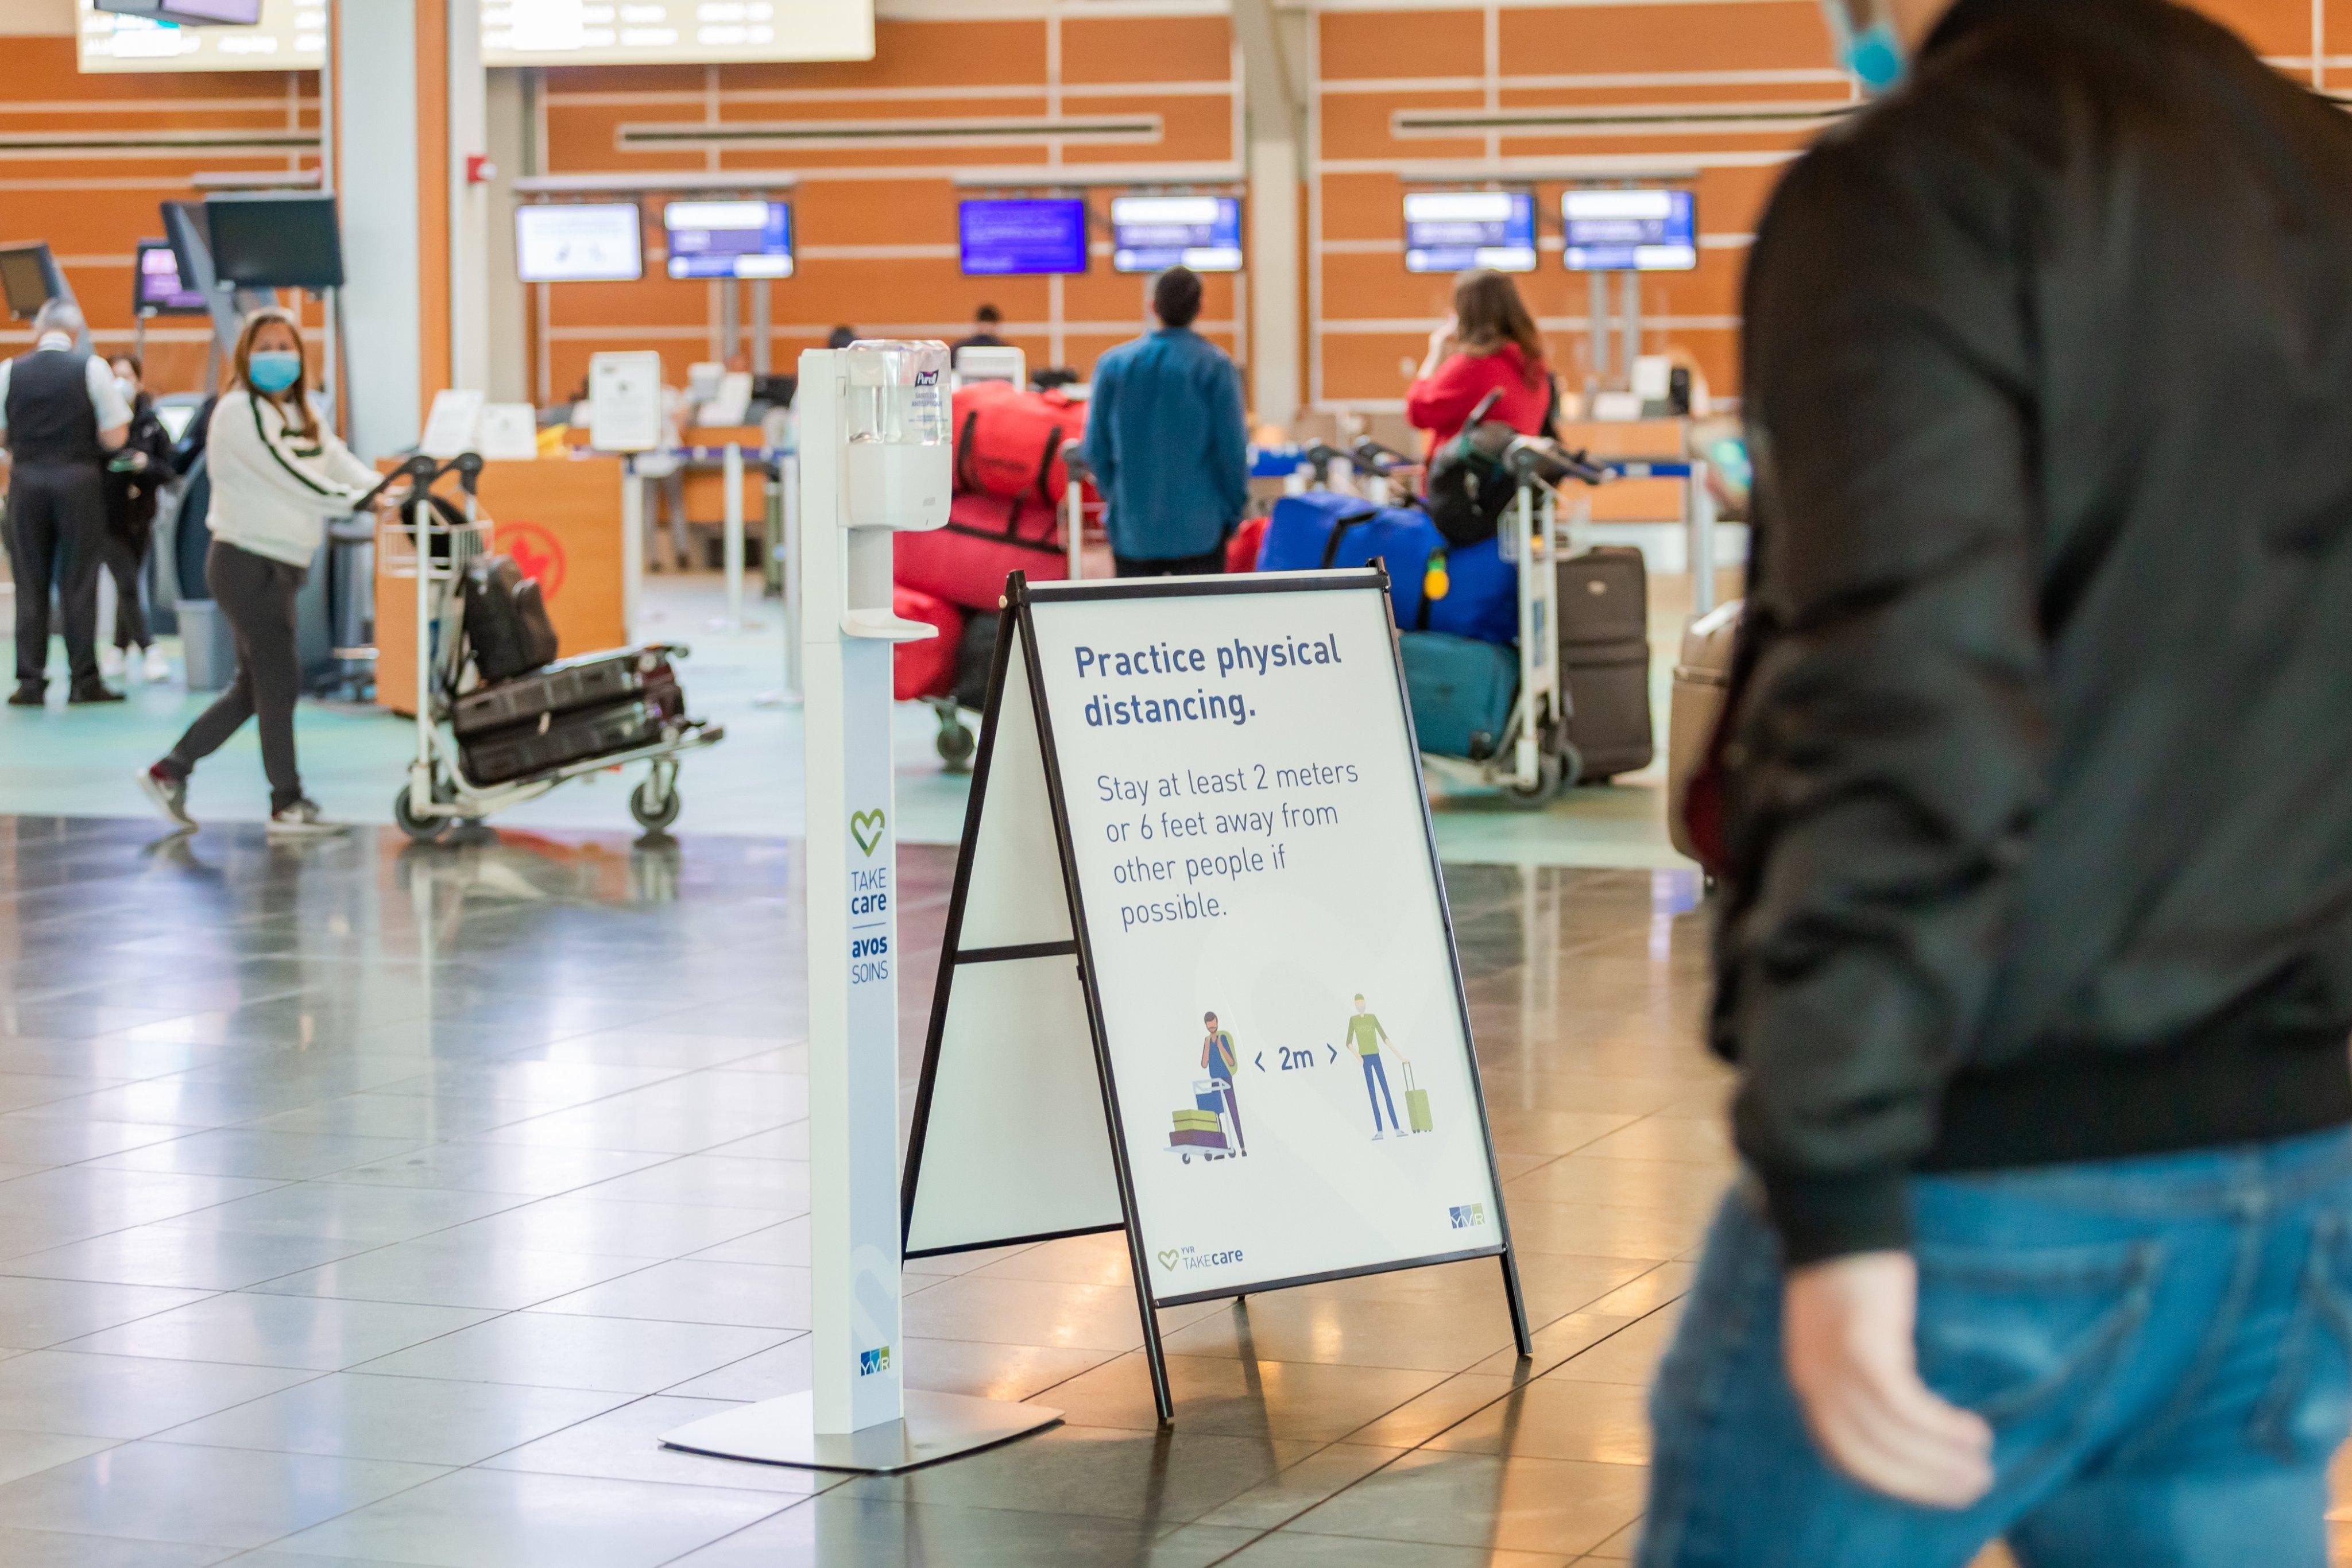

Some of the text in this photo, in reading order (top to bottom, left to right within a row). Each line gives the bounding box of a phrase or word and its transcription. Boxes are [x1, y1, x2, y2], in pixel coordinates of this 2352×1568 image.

[1074, 633, 1342, 679] Practice physical
[1085, 688, 1256, 727] distancing.
[1097, 762, 1359, 806] Stay at least 2 meters
[1106, 802, 1338, 842] or 6 feet away from
[1113, 843, 1286, 885] other people if
[851, 867, 887, 892] TAKE
[851, 893, 887, 915] care
[1121, 892, 1227, 933] possible.
[852, 936, 887, 958] avos
[852, 960, 888, 985] SOINS
[1278, 1046, 1314, 1071] 2m
[1450, 1211, 1486, 1229] YVR
[1181, 1245, 1195, 1255] YVR
[861, 1356, 890, 1376] YVR
